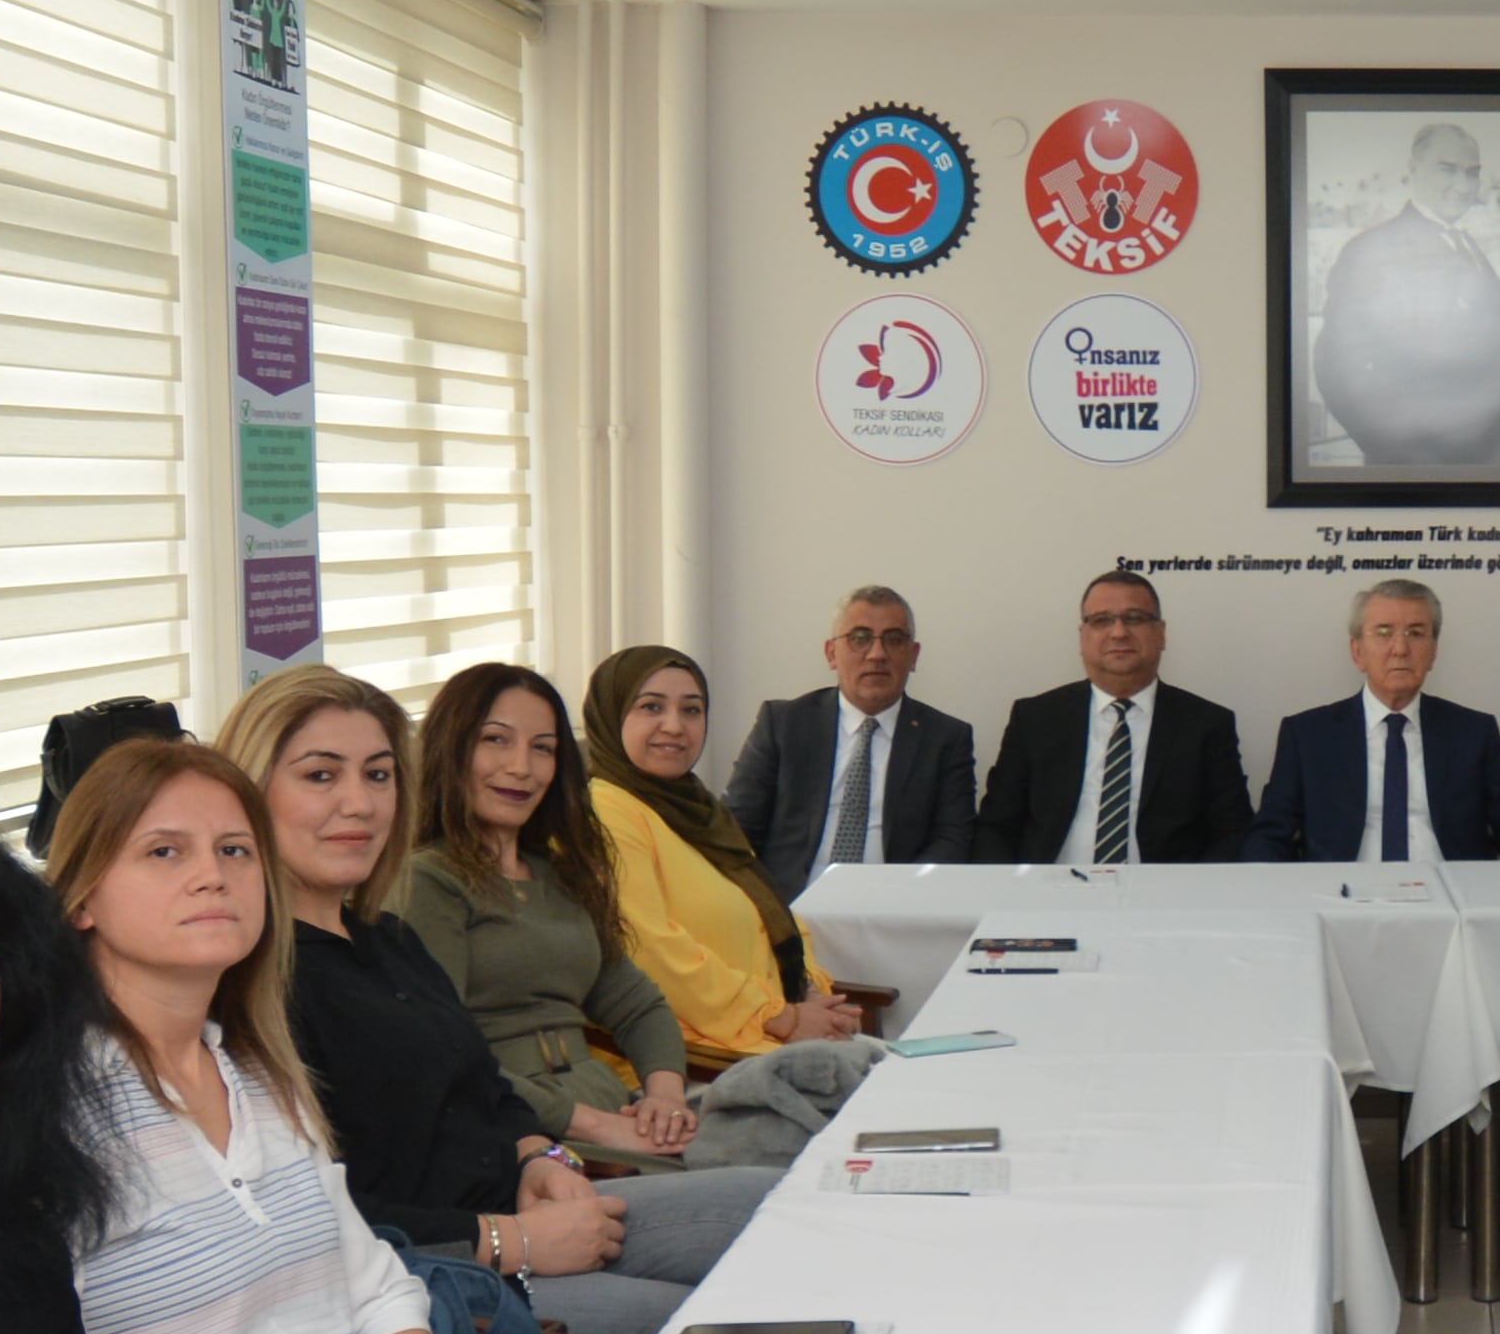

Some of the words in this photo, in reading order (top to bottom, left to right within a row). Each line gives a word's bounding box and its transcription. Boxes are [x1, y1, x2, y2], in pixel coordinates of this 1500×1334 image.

[833, 121, 954, 172] TÜRK-İŞ
[852, 233, 929, 259] 1952
[1037, 200, 1181, 272] TEKSİF
[1076, 371, 1158, 398] birlikte
[1078, 402, 1159, 431] varız
[1346, 526, 1423, 542] kahraman
[1428, 525, 1463, 542] Türk
[1116, 556, 1144, 573] Sen
[1148, 555, 1212, 575] yerlerde
[1217, 555, 1302, 575] sürünmeye
[1306, 554, 1348, 575] değil,
[1352, 555, 1414, 571] omuzlar
[1417, 554, 1483, 571] üzerinde
